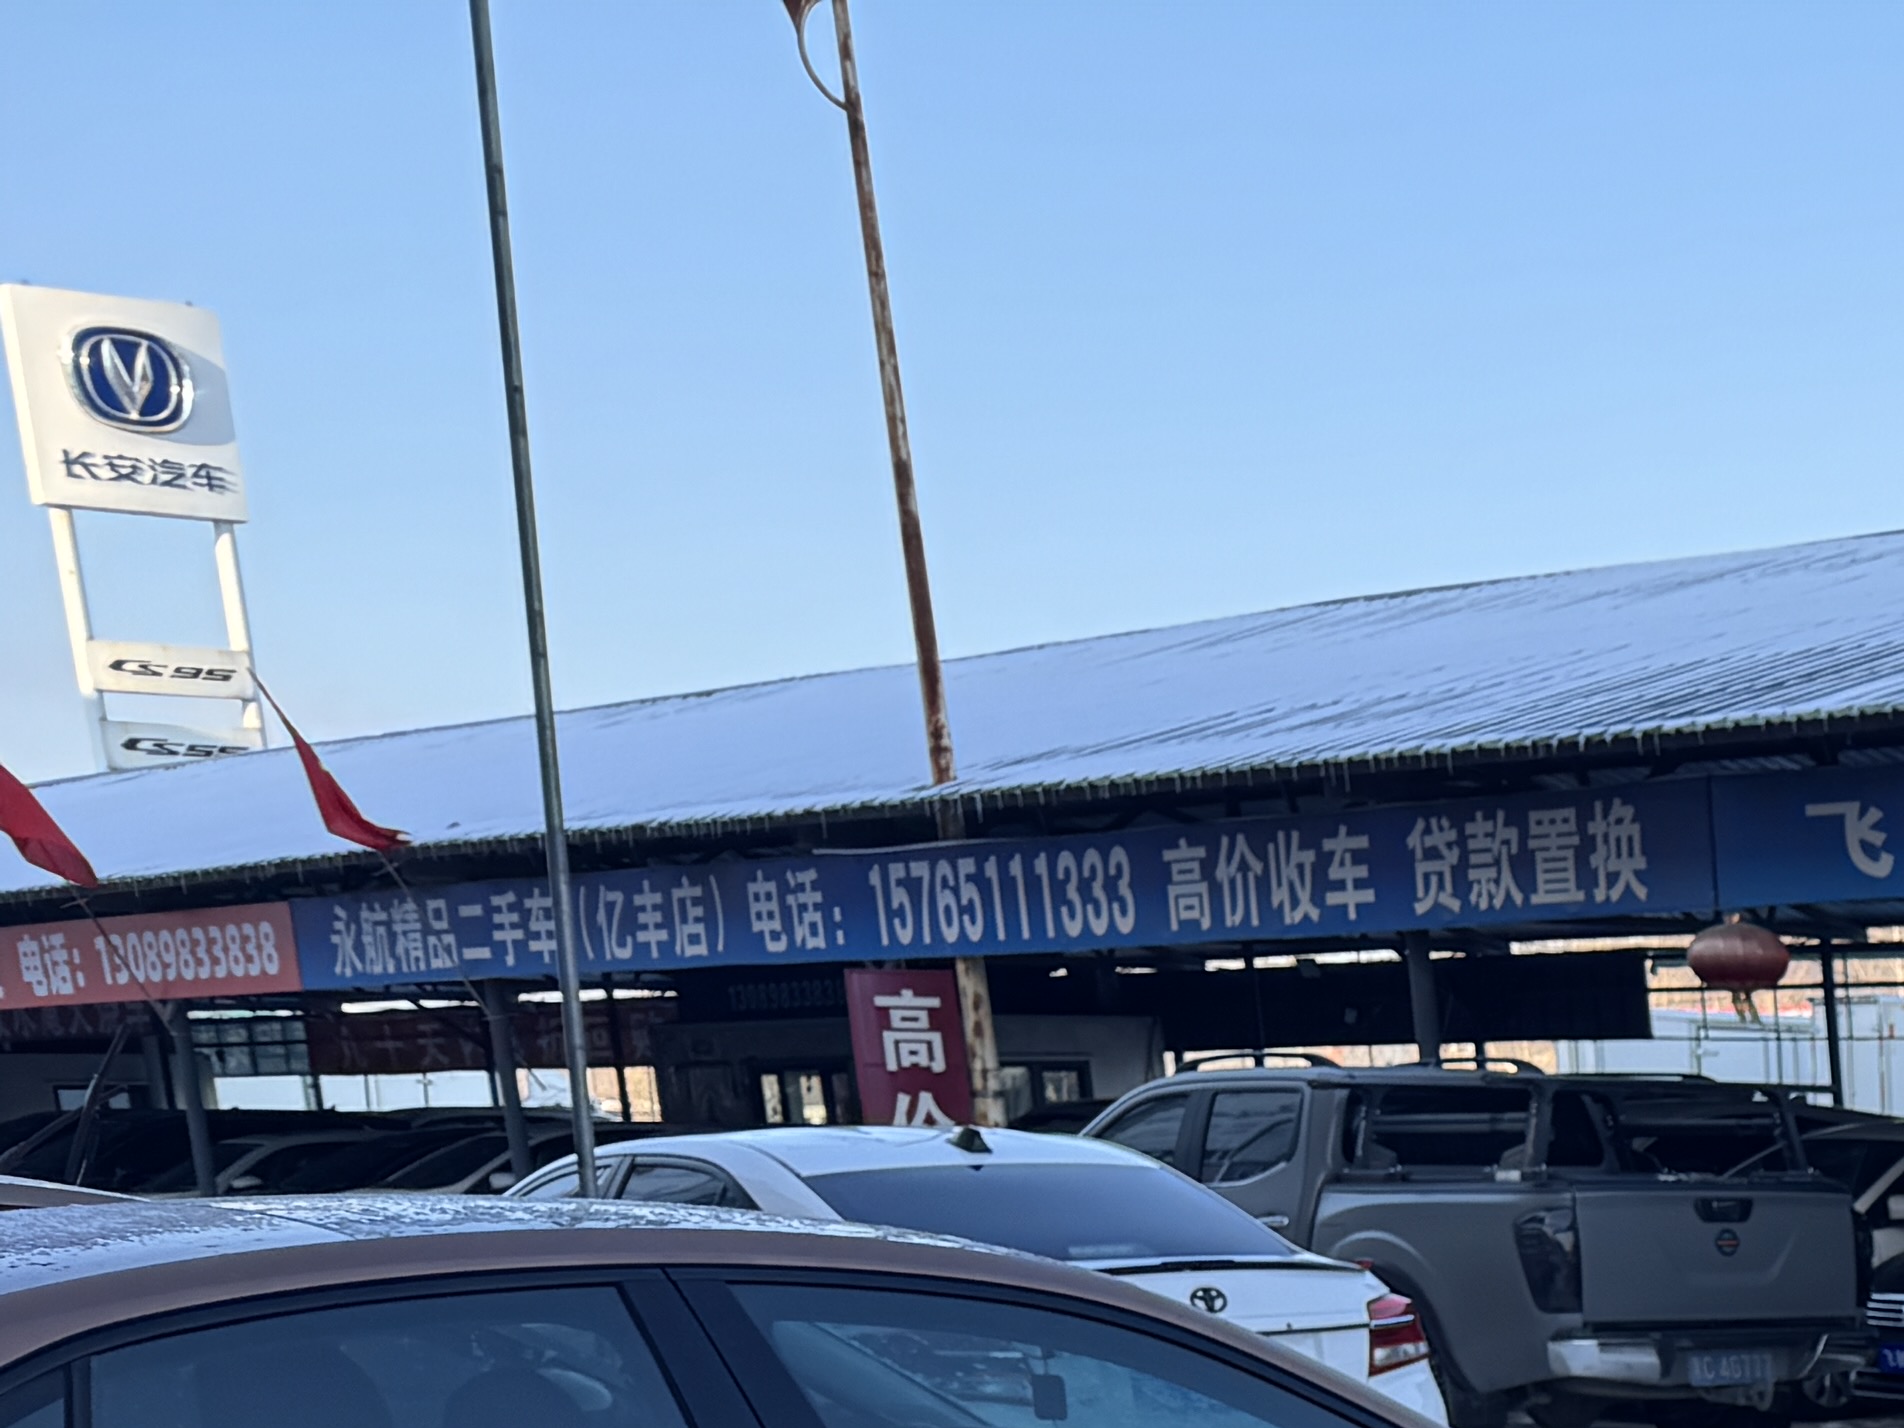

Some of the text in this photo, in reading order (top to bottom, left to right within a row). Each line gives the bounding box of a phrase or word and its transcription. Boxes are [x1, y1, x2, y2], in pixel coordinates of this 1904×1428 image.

[60, 449, 240, 494] 长安汽车
[108, 659, 237, 681] CS95
[868, 846, 1136, 946] 15765111333
[1163, 825, 1375, 930] 高价收车
[1406, 798, 1648, 915] 贷款置换
